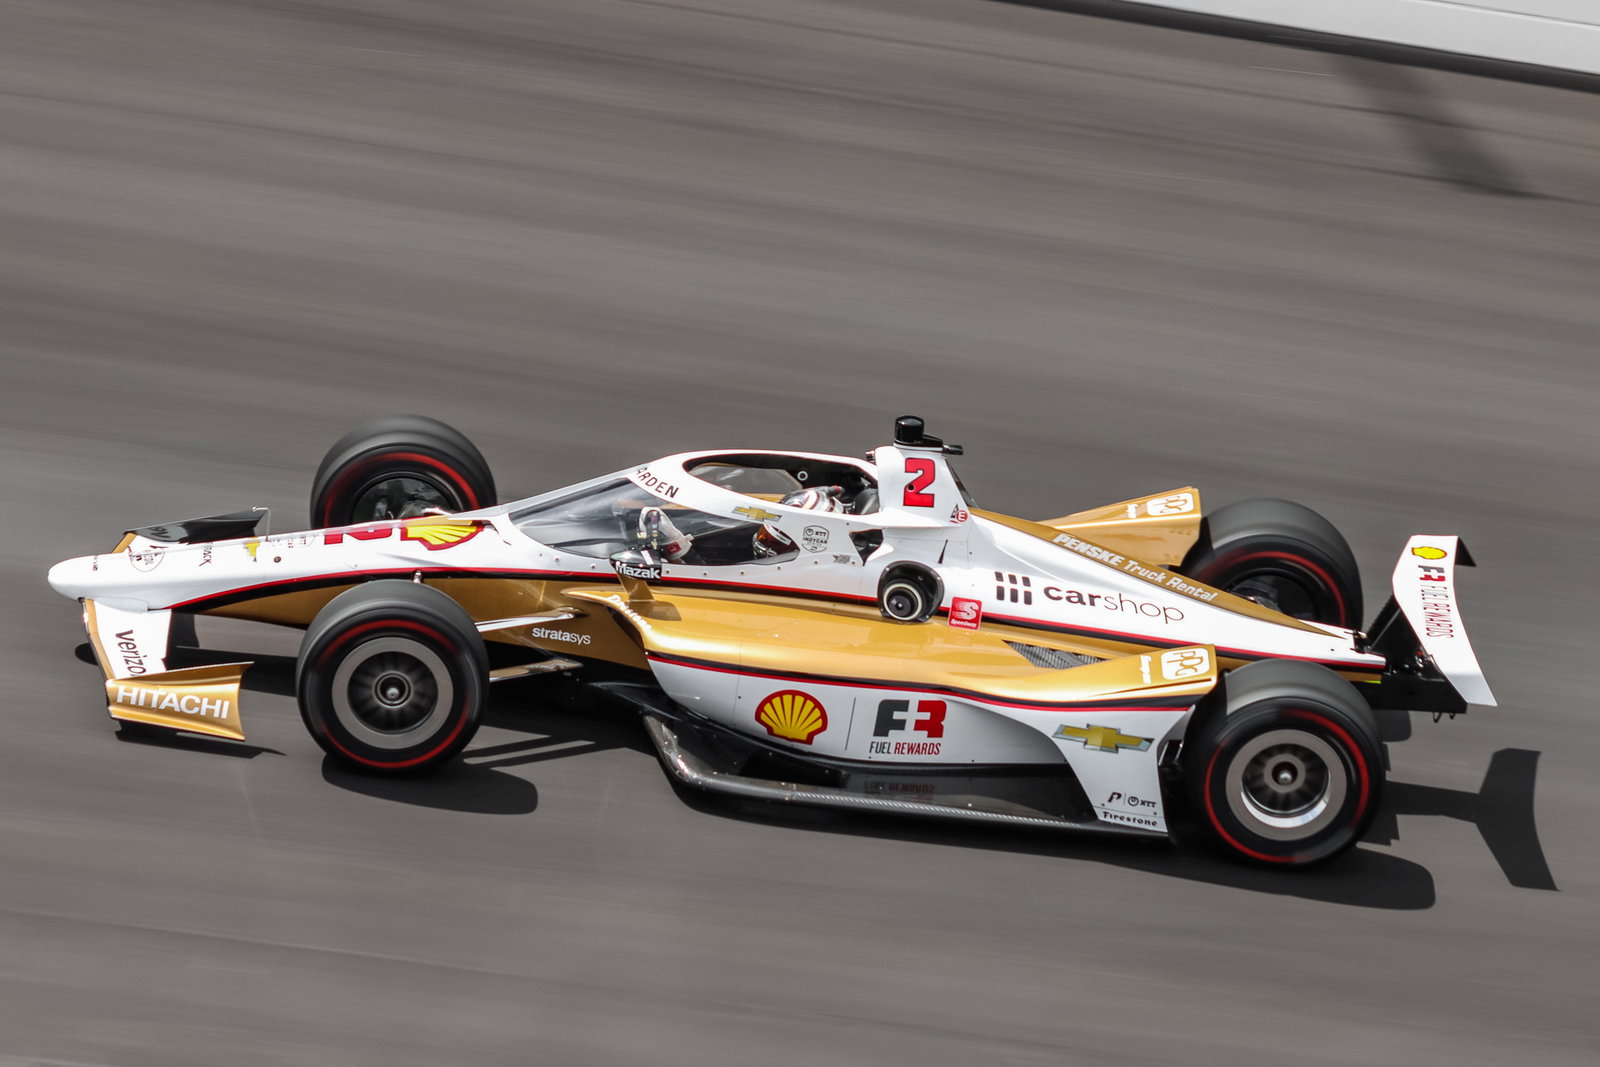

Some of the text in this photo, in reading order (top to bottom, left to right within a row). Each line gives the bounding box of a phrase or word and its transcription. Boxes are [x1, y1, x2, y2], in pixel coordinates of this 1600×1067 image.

[903, 457, 936, 508] 2
[615, 560, 661, 579] Mazak
[1052, 532, 1219, 602] PENSKE Truck Rental
[1043, 585, 1185, 624] carshop
[114, 629, 147, 676] verizo
[531, 626, 591, 645] stratasys
[116, 684, 230, 719] HITACHI
[869, 741, 941, 755] FUEL REWARDS
[1103, 811, 1158, 826] Firestone
